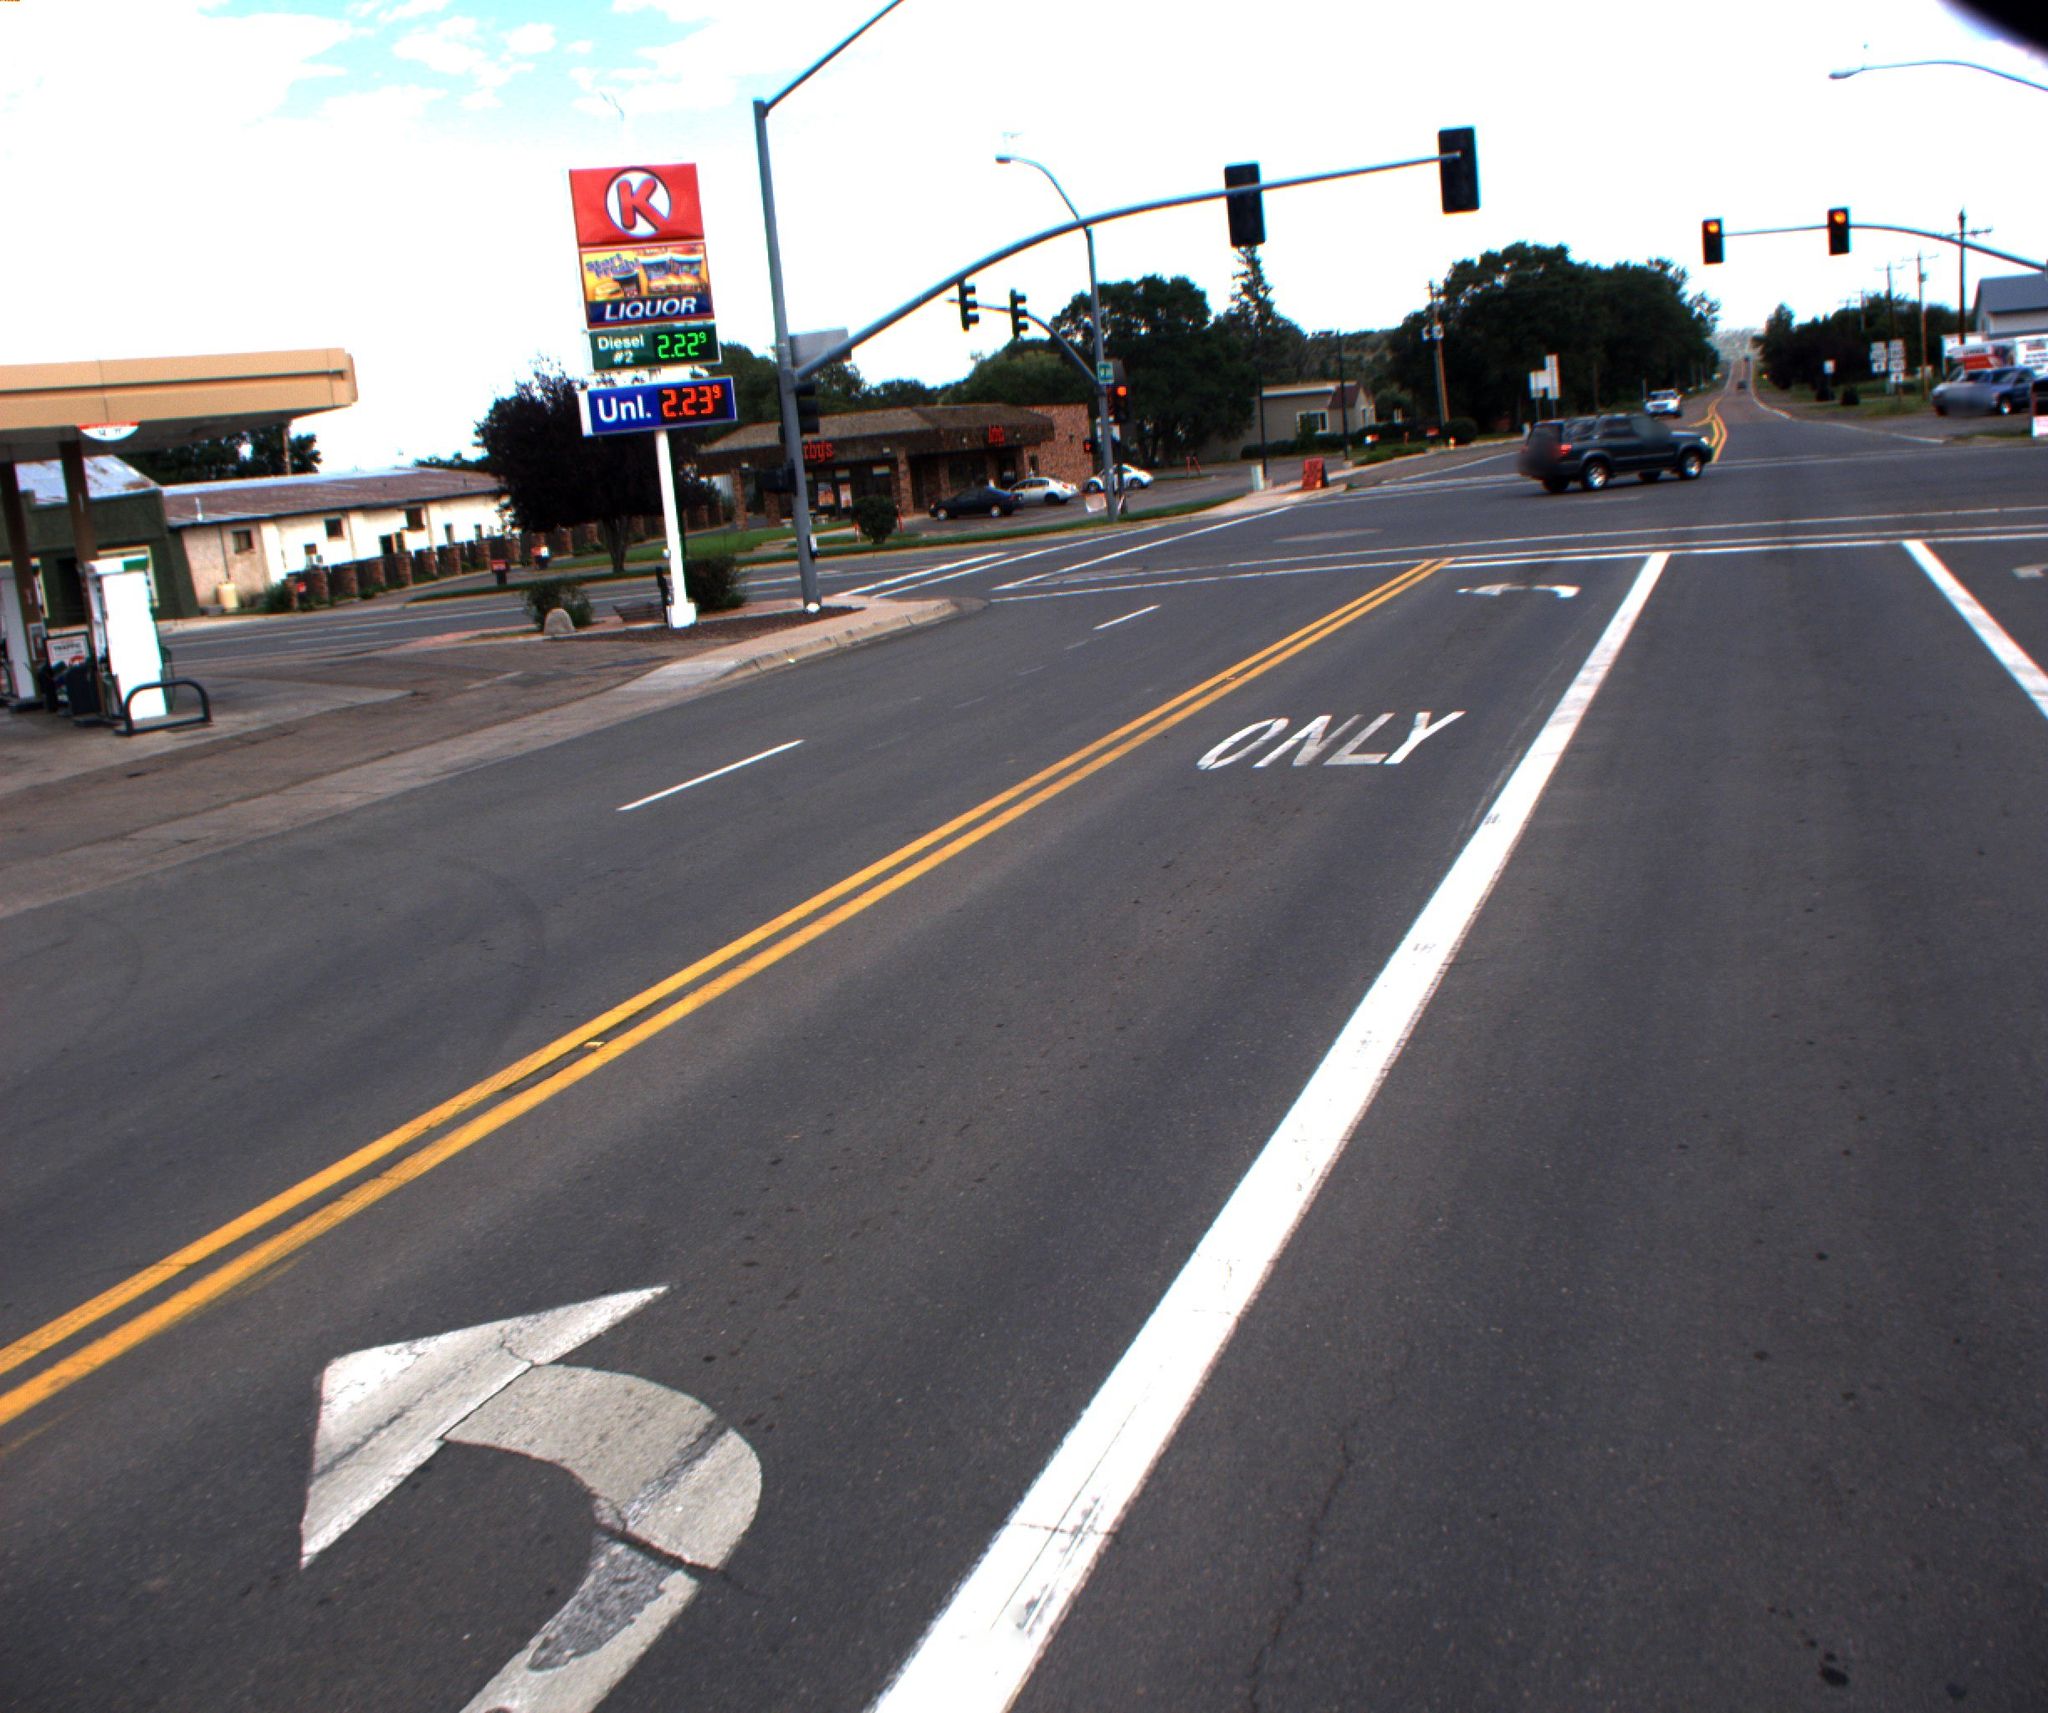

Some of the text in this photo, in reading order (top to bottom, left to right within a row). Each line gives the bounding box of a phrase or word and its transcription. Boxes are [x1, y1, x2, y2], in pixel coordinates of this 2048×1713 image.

[616, 177, 670, 233] K
[605, 296, 697, 321] LIQUOR
[597, 333, 645, 351] Diesel
[613, 350, 634, 365] #2
[597, 394, 652, 423] Unl.
[1195, 709, 1468, 771] ONLY
